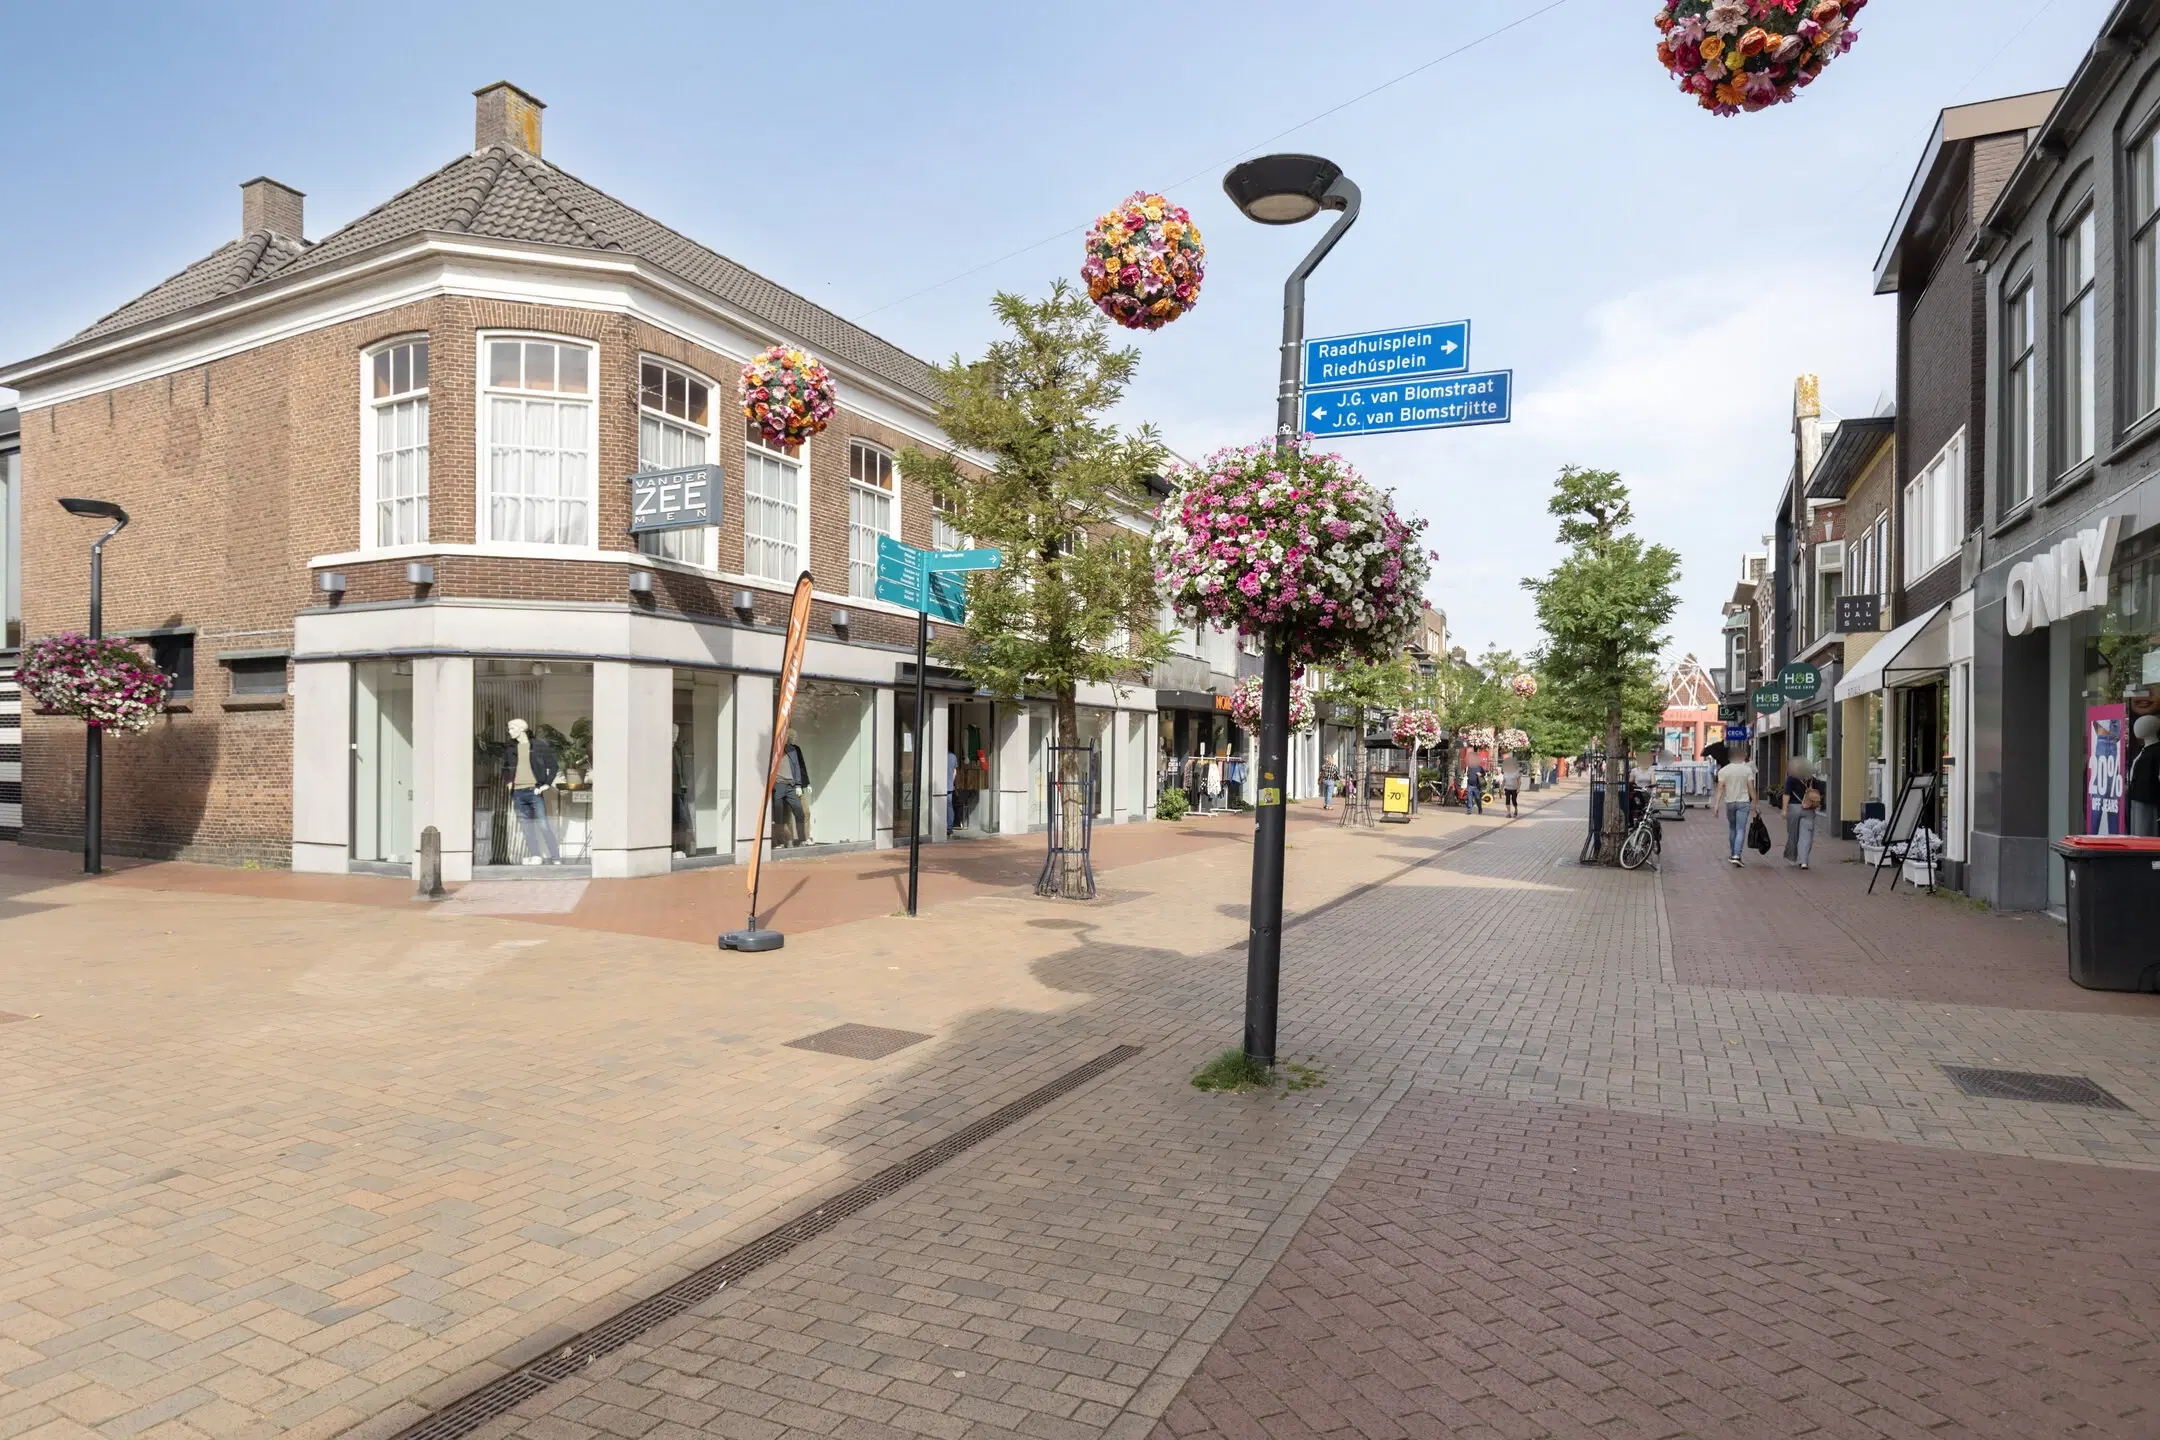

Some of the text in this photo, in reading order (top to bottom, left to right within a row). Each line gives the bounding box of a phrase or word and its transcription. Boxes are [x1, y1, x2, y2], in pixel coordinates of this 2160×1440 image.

[1319, 333, 1432, 359] Raadhuisplein
[1323, 354, 1426, 376] Riedhúsplein
[1337, 379, 1495, 408] J.G. van Blomstraat
[1333, 400, 1497, 428] J.G. van Blomstrjitte
[635, 471, 707, 488] VAN DER
[635, 480, 707, 516] ZEE
[634, 509, 707, 524] MEN
[2006, 516, 2122, 637] ONLY
[2088, 755, 2123, 798] 20%
[2092, 797, 2119, 814] OFF JEANS
